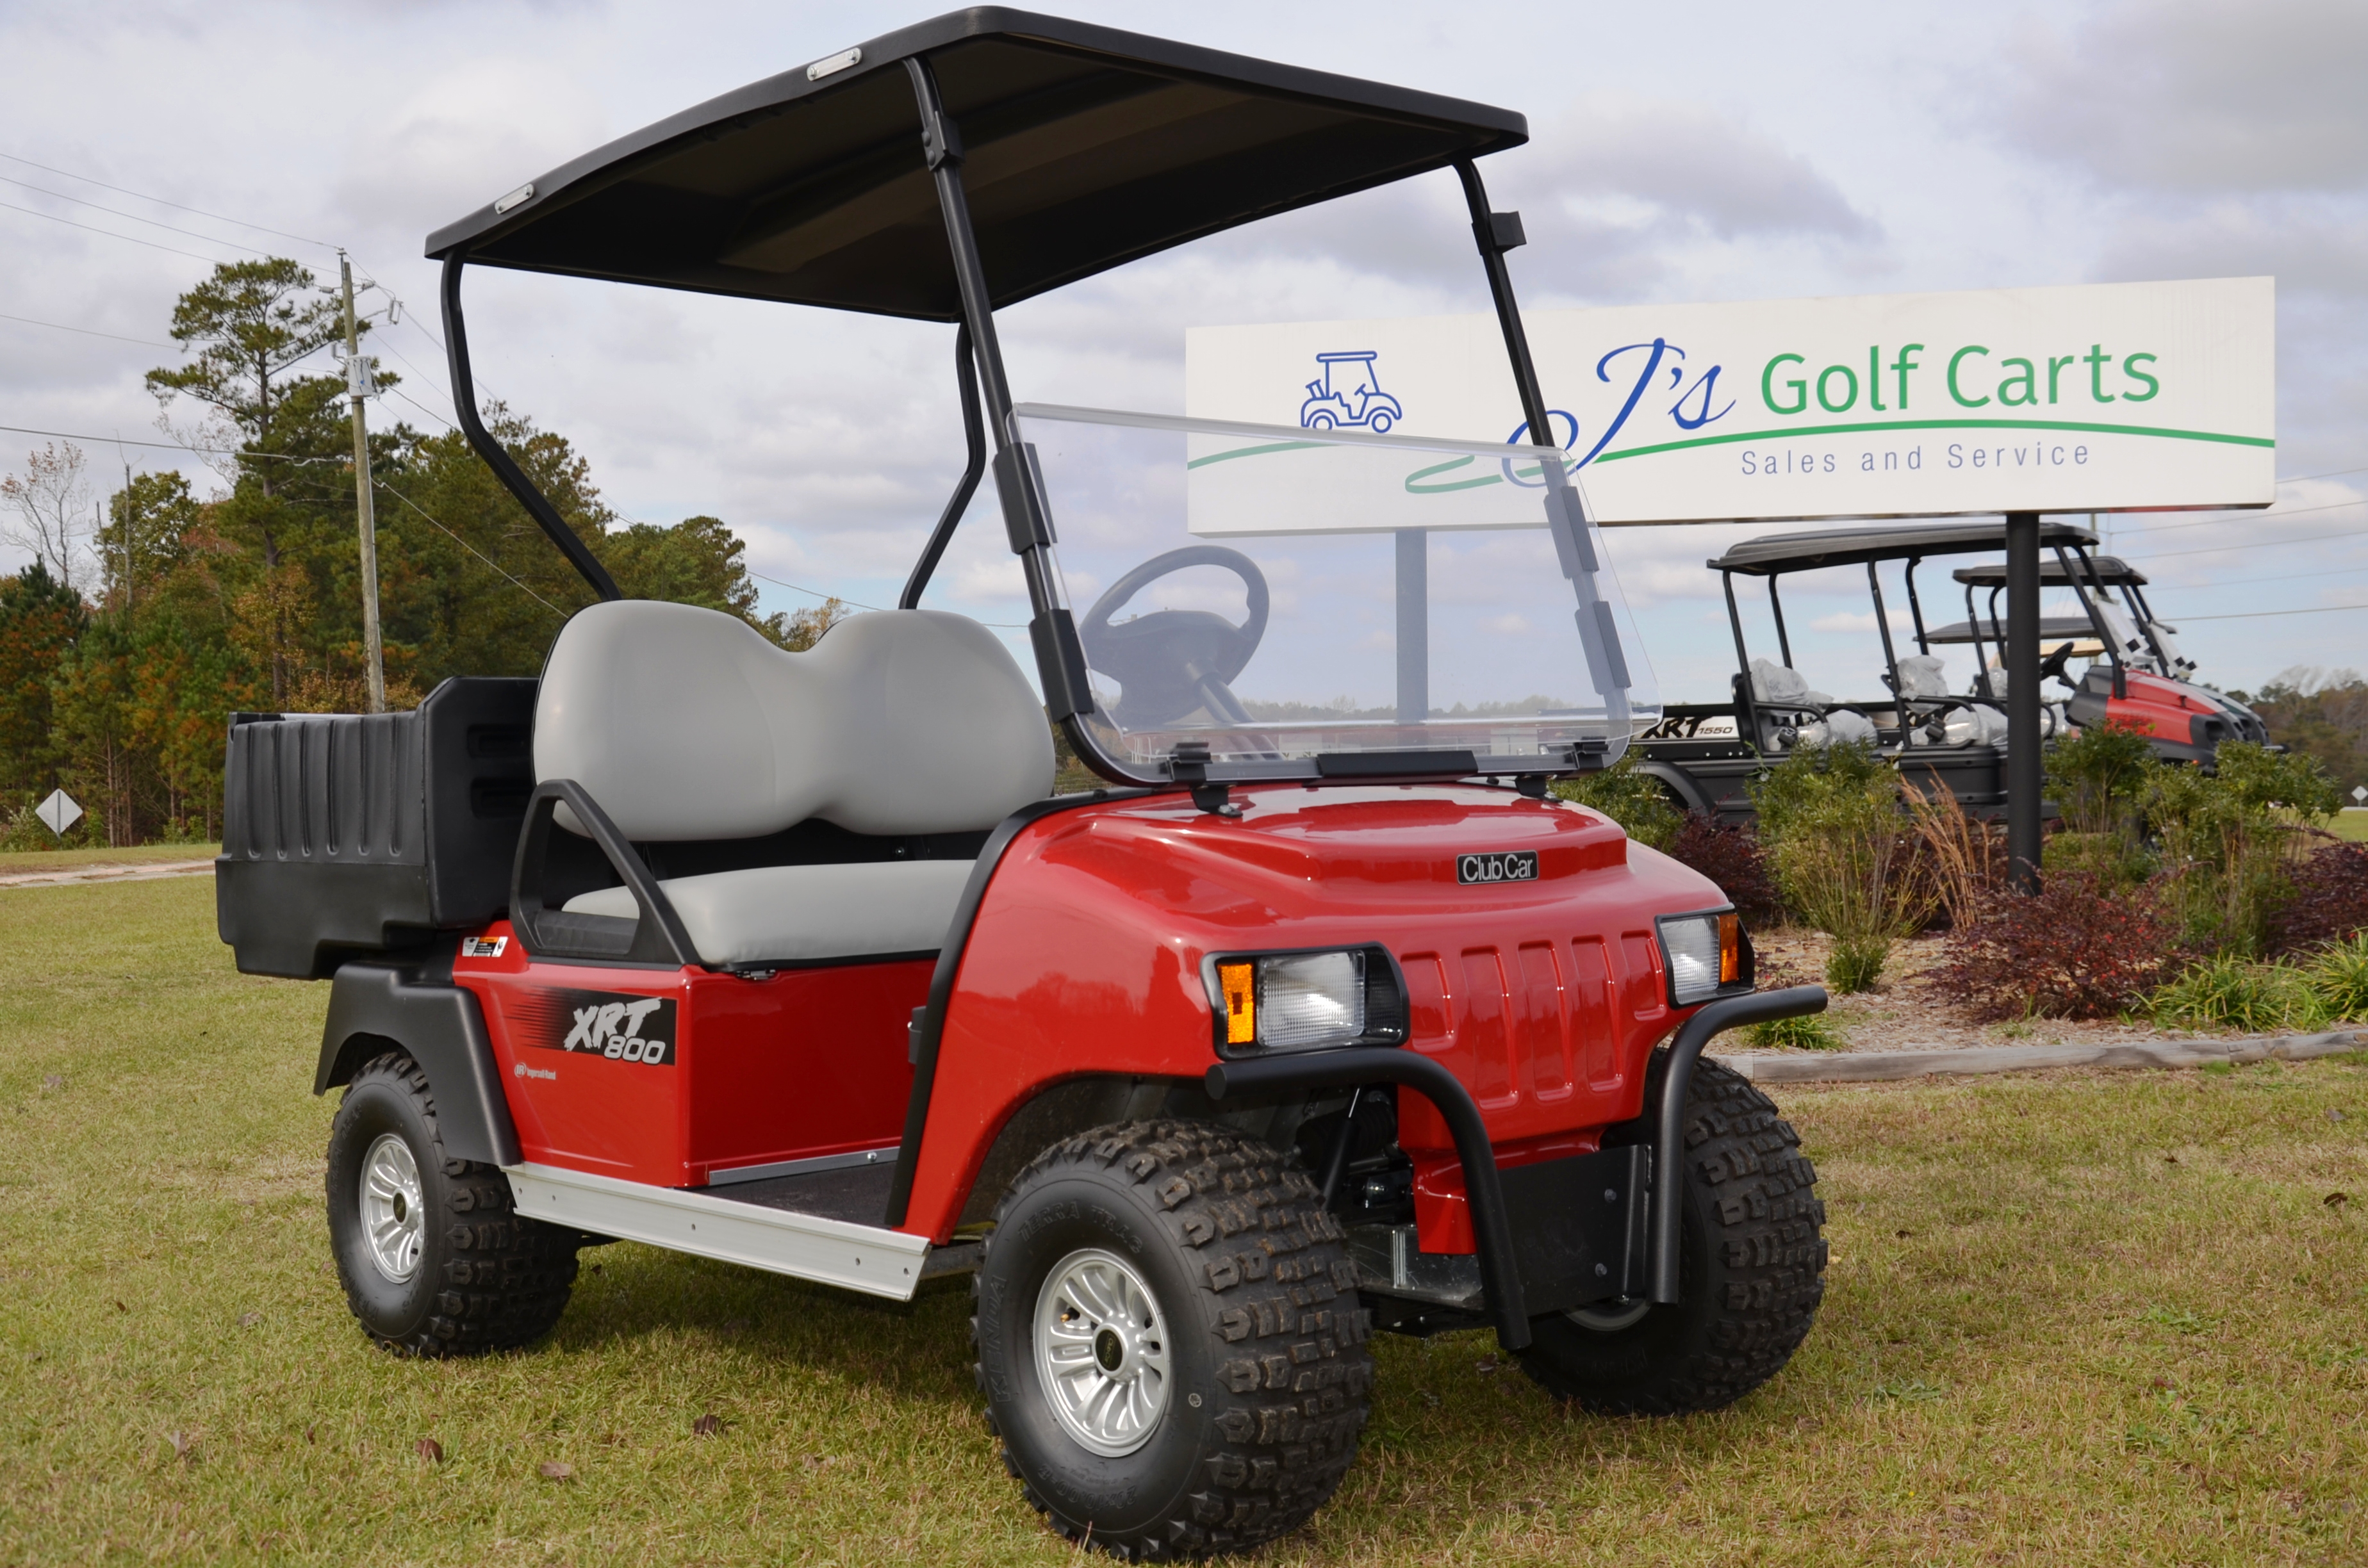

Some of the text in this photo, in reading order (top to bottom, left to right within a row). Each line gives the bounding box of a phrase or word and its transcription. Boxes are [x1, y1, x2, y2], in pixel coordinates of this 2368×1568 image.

[1501, 337, 2160, 488] J's Golf Carts
[1741, 441, 2089, 475] Sales and Service
[1463, 854, 1533, 881] Club Car
[564, 997, 661, 1051] XRT
[604, 1035, 666, 1065] 800
[1018, 1201, 1143, 1254] TERRA TRAC
[985, 1275, 1011, 1403] KENDA
